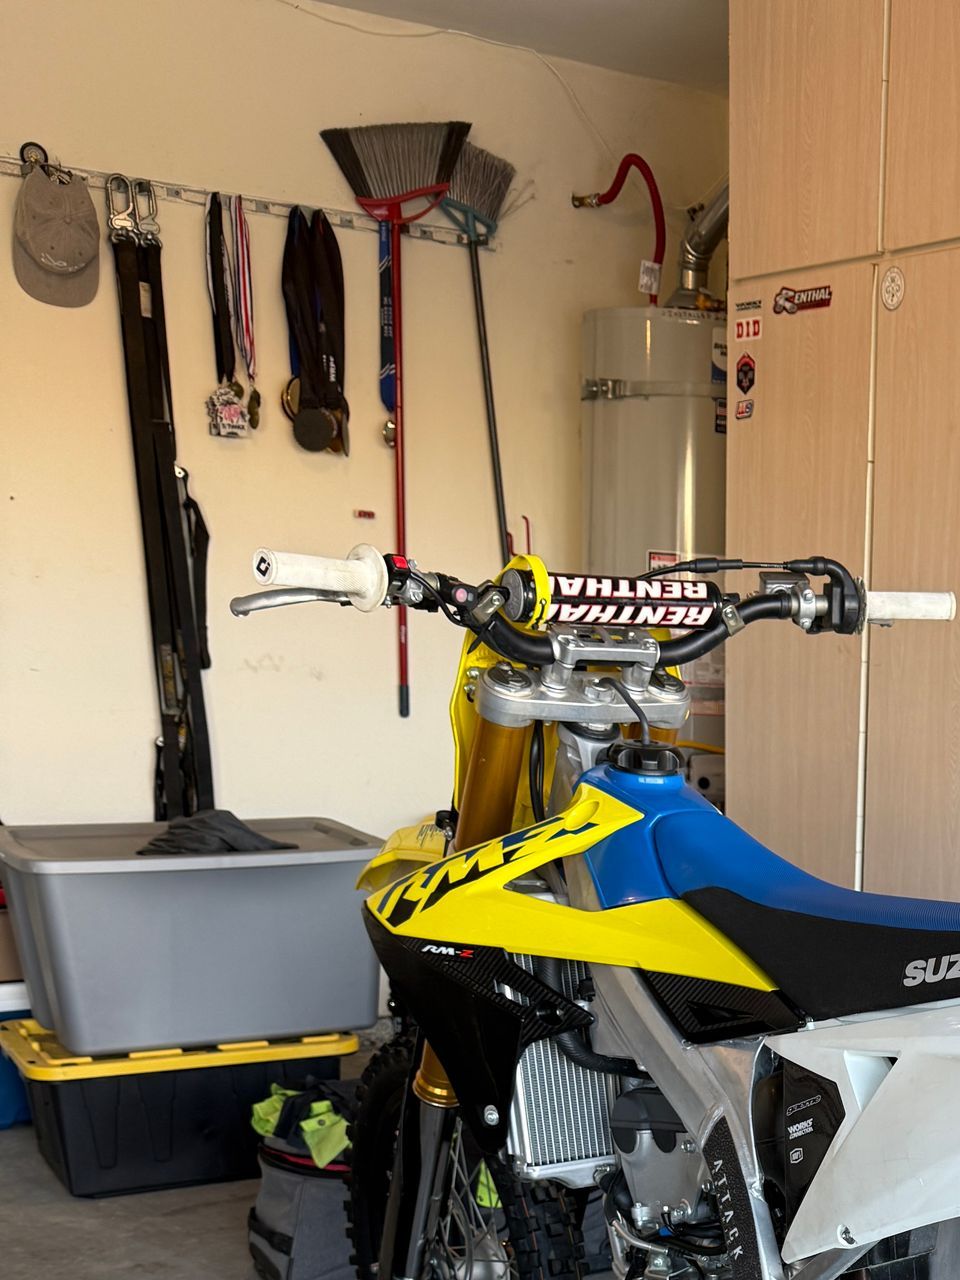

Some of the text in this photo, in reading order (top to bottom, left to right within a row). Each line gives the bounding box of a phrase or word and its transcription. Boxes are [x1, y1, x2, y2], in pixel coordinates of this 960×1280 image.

[421, 944, 474, 959] RM-Z
[787, 1117, 814, 1135] WORKS
[713, 1159, 744, 1261] ATTACK
